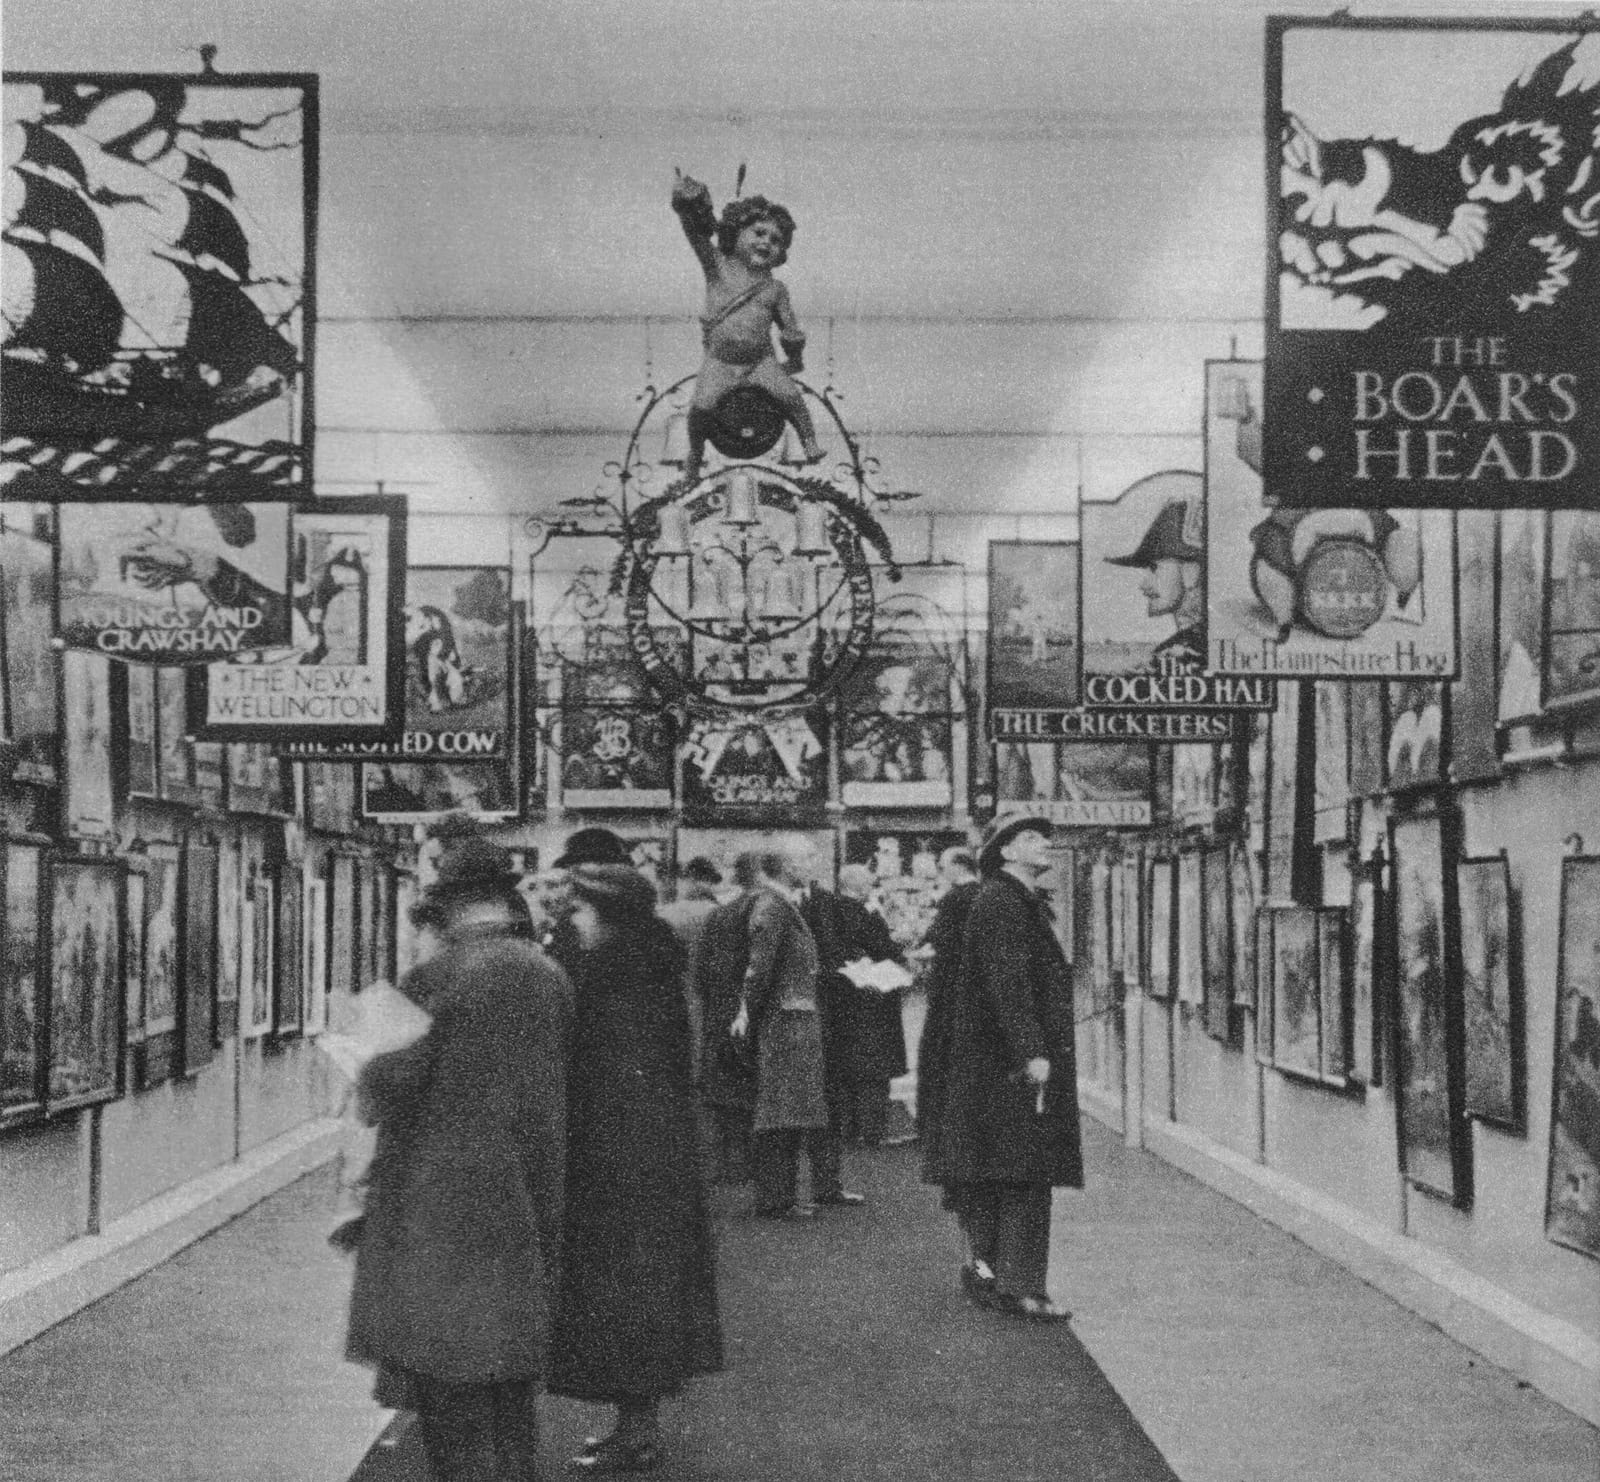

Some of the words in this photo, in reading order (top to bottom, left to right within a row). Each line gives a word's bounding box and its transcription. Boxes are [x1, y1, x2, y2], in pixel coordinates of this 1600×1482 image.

[1426, 336, 1506, 366] THE
[1353, 371, 1578, 422] BOAR'S
[1353, 428, 1577, 481] HEAD
[200, 605, 263, 629] AND
[98, 629, 246, 651] CRAWSHAY
[1157, 655, 1199, 677] The
[1205, 638, 1257, 670] The
[1261, 638, 1394, 675] Hampshire
[1396, 641, 1448, 677] Hog
[236, 668, 285, 692] THE
[295, 668, 355, 692] NEW
[1087, 676, 1208, 702] COCKED
[213, 695, 380, 719] WELLINGTON
[998, 712, 1049, 734] THE
[1060, 712, 1226, 735] CRICKETERS
[438, 731, 496, 752] COW
